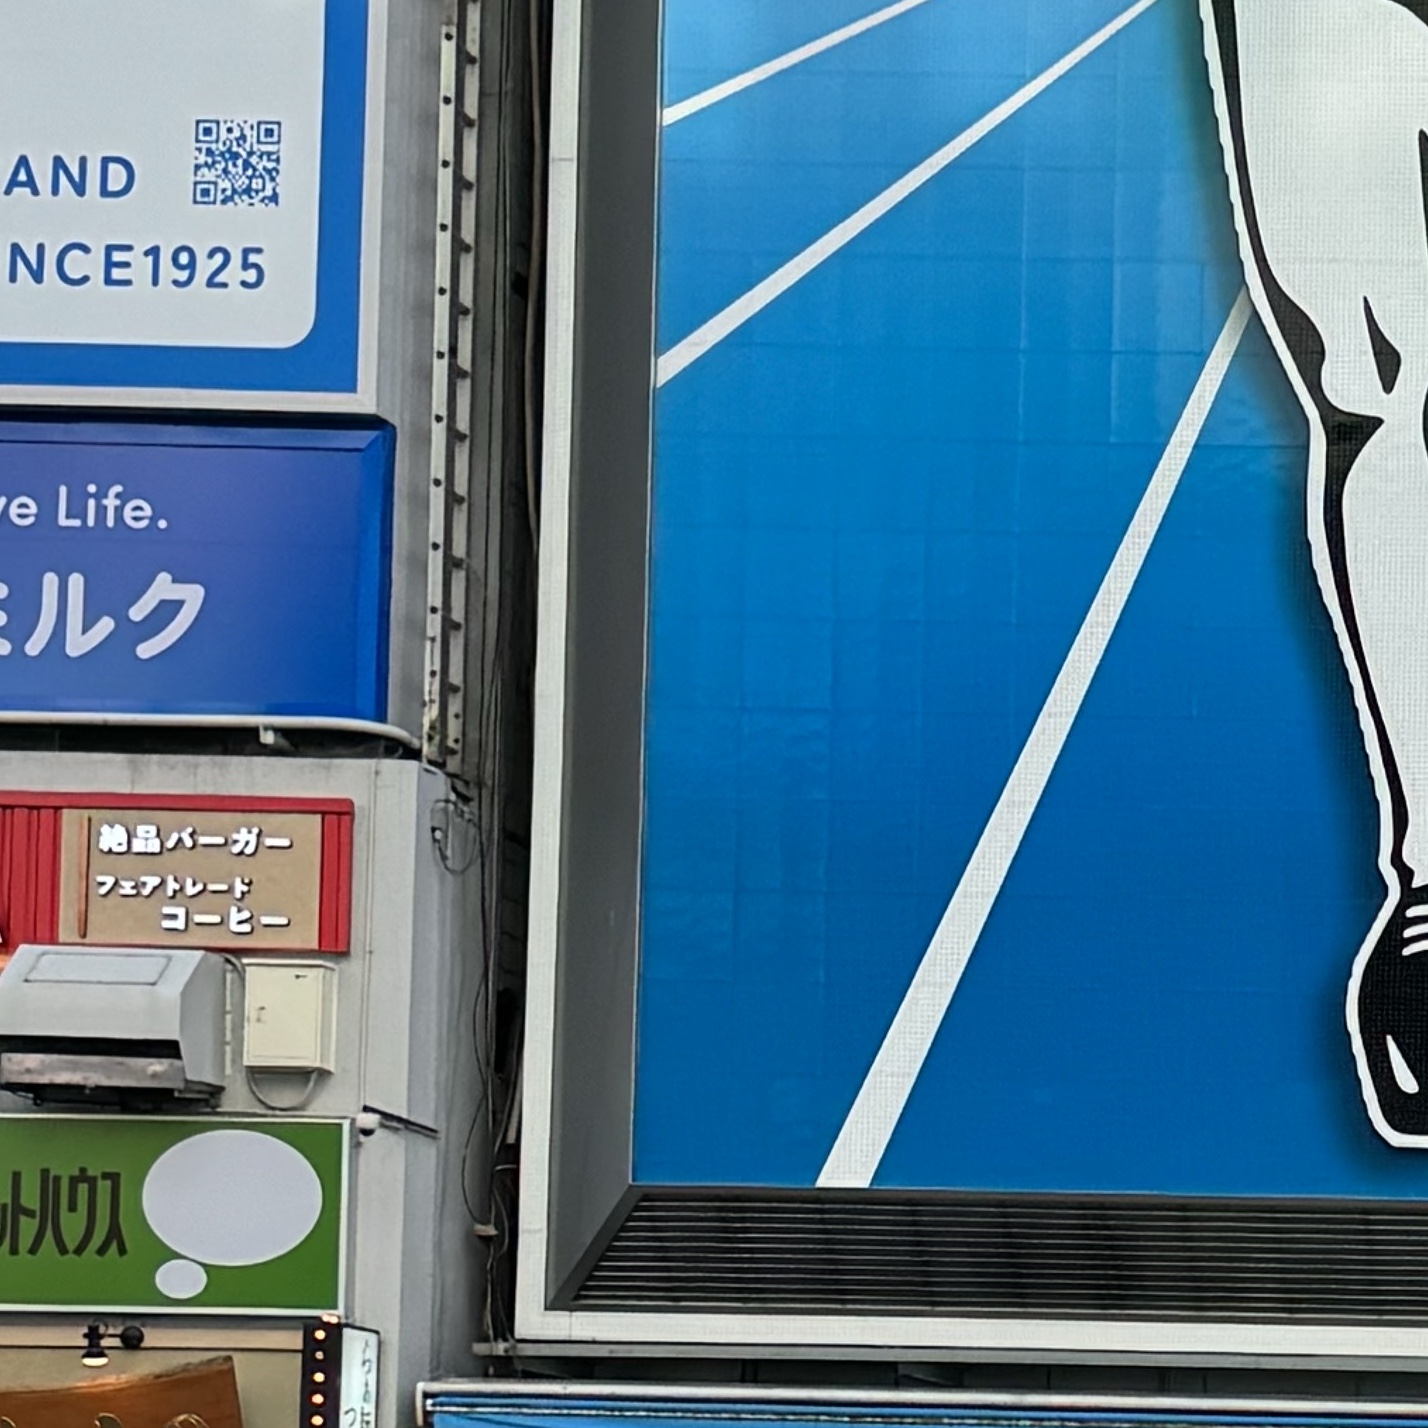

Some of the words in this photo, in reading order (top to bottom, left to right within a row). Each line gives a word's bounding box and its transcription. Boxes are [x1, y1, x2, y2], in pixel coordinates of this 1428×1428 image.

[57, 484, 169, 530] Life.
[96, 874, 252, 900] フェアトレード
[160, 905, 291, 934] コーヒー
